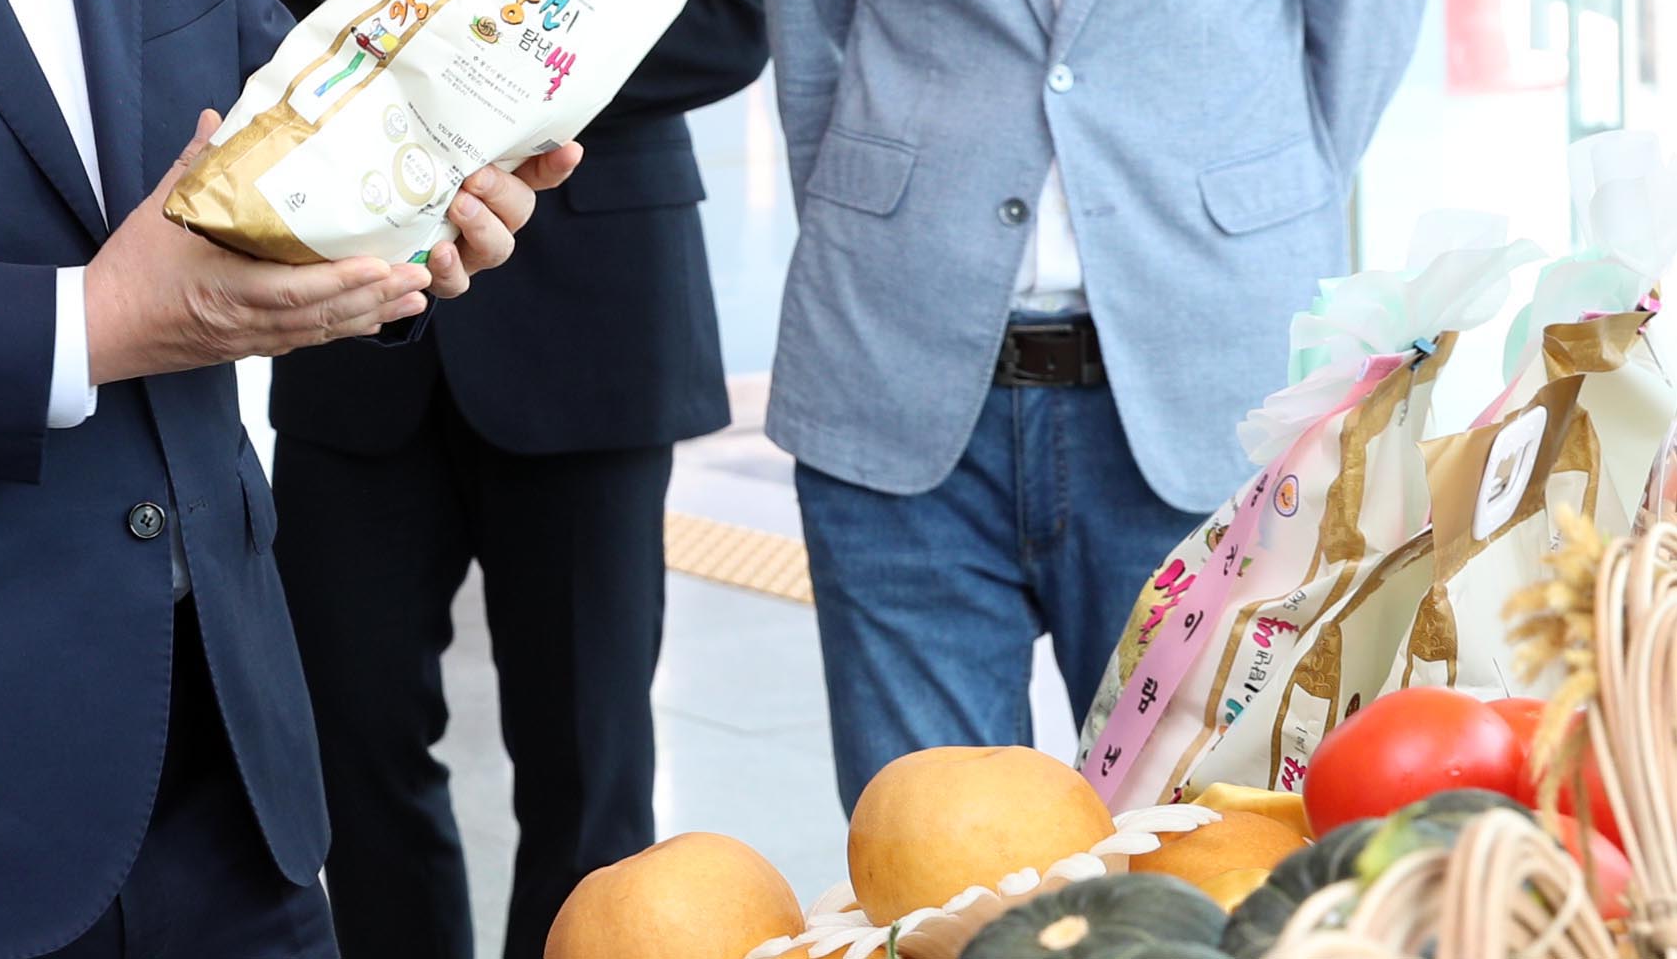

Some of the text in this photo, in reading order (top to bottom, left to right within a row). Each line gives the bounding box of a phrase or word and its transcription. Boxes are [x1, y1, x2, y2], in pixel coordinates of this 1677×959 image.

[519, 28, 554, 62] 탐낸
[544, 46, 577, 103] 쌀
[1249, 590, 1307, 681] 탐낸 쌀 5kg
